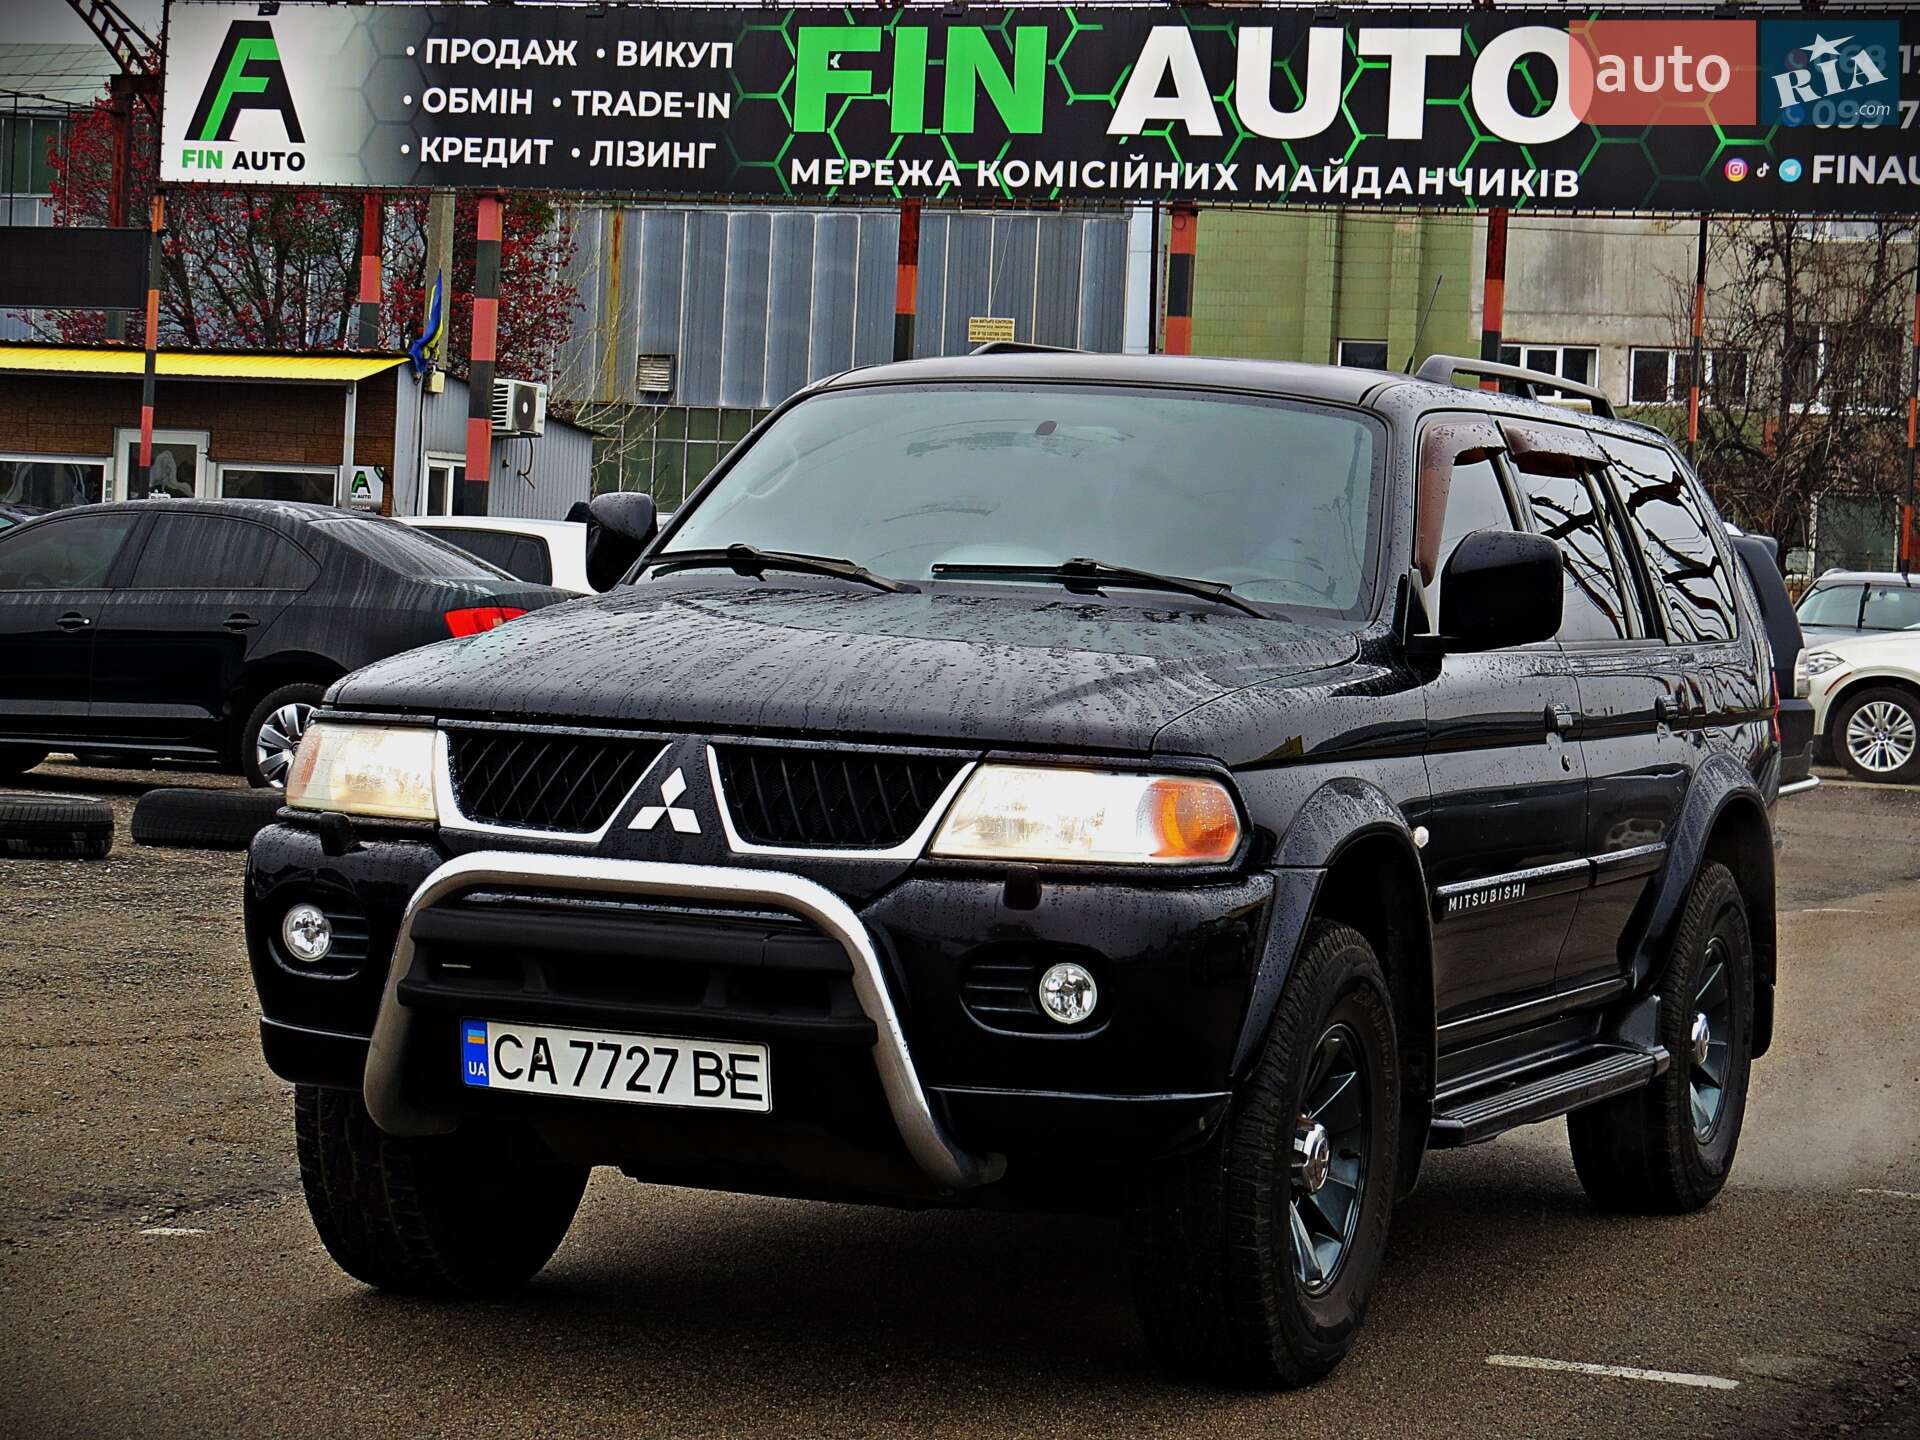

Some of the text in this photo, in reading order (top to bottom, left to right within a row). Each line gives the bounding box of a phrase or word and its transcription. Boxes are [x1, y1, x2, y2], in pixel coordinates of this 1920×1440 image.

[425, 38, 734, 70] ПРОДАЖ ВИКУП
[793, 24, 1594, 144] FIN AUTO
[422, 87, 533, 115] ОБМІН
[571, 89, 731, 119] TRADE-IN
[181, 149, 306, 172] FIN AUTO
[420, 136, 718, 169] КРЕДИТ ЛІЗИНГ
[790, 154, 1580, 198] МЕРЕЖА КОМІСІЙНИХ МАЙДАНЧИКІВ
[1448, 882, 1526, 911] MITSUBISHI
[468, 1060, 487, 1077] UA
[493, 1033, 763, 1101] CA 7727 BE
